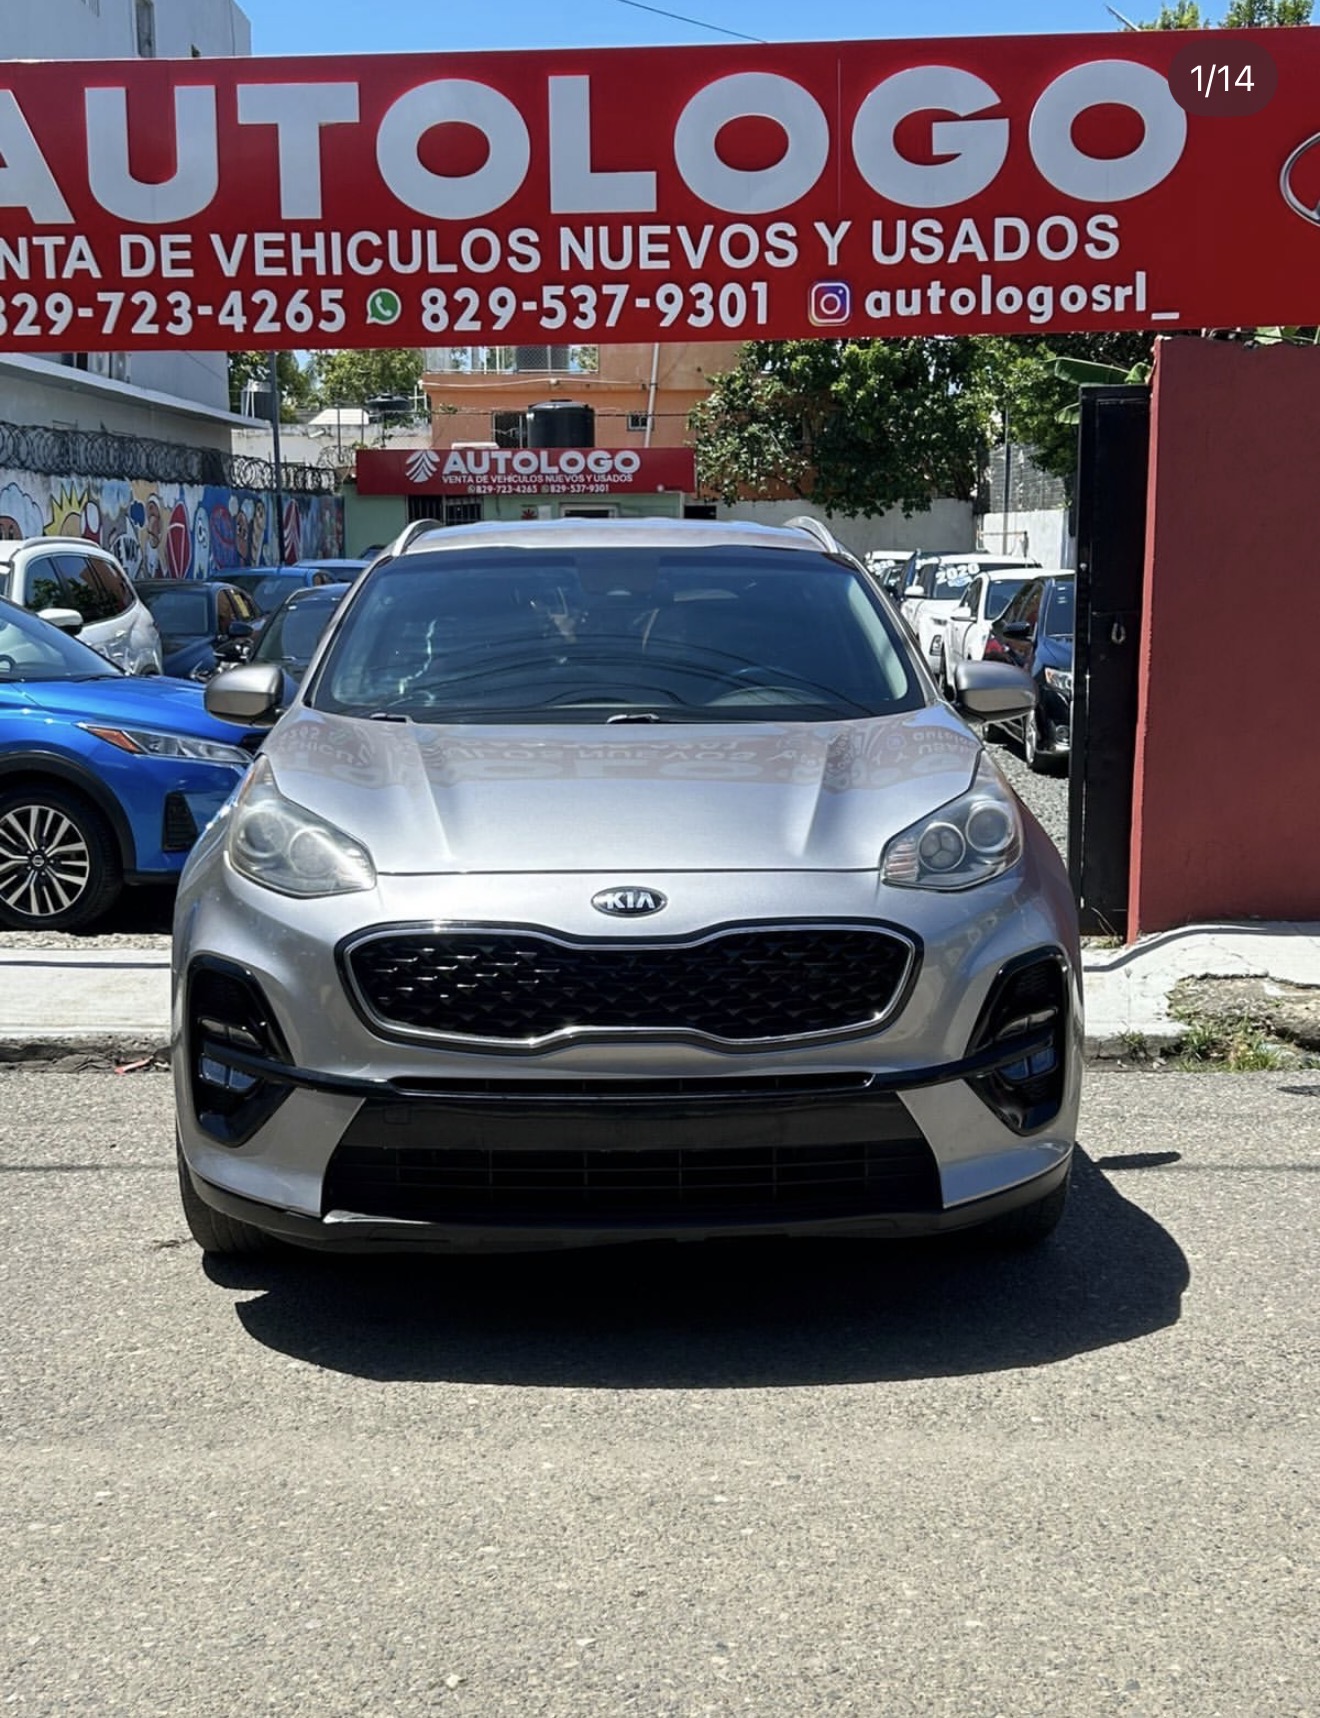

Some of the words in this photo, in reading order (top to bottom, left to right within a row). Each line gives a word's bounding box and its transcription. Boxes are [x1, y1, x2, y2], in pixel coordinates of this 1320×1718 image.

[120, 233, 195, 278] DE
[210, 226, 541, 277] VEHICULOS
[559, 222, 798, 272] NUEVOS
[814, 220, 853, 266] Y
[872, 214, 1121, 265] USADOS
[0, 288, 347, 336] 29-723-4265
[421, 282, 768, 333] 829-537-9301
[442, 450, 641, 475] AUTOLOGO
[442, 474, 474, 484] VENTA
[475, 474, 489, 484] DE
[545, 473, 586, 483] NUEVOS
[586, 473, 593, 483] Y
[593, 472, 633, 483] USADOS
[935, 562, 980, 585] 2020
[606, 891, 656, 910] KIA
